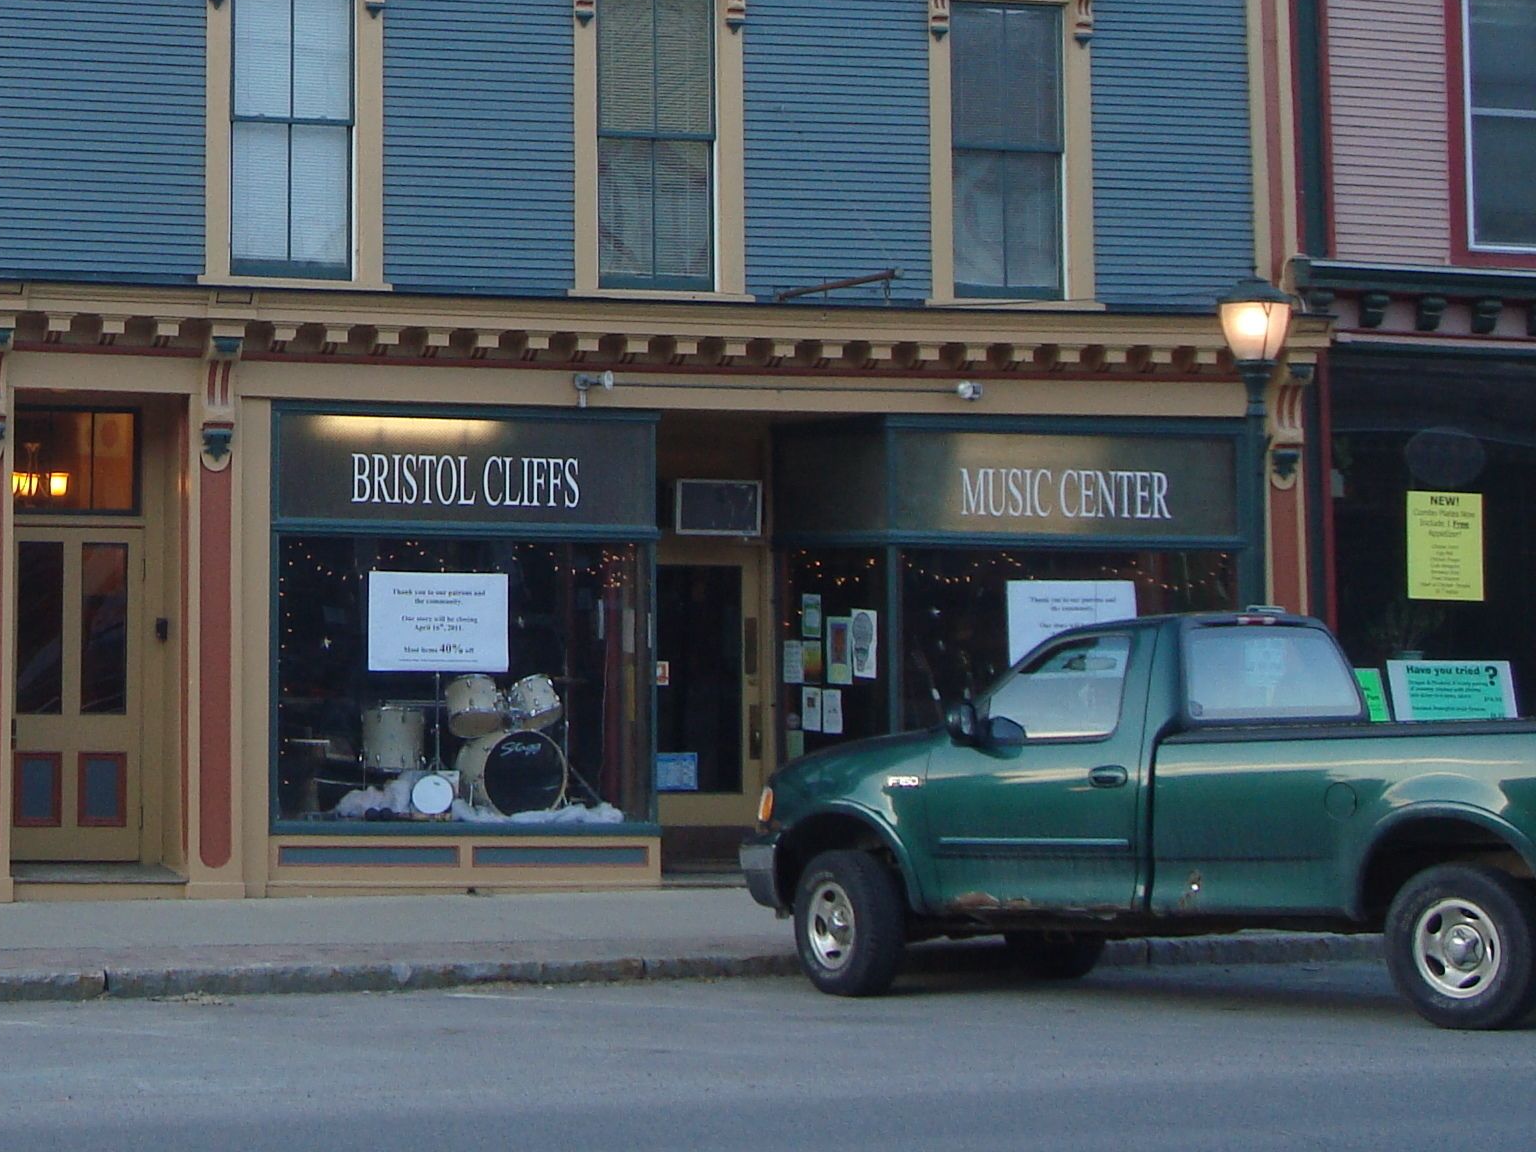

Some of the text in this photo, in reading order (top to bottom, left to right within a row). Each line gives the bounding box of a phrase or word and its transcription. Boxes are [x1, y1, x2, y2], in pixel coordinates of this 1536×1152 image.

[350, 453, 580, 508] BRISTOL CLIFFS
[960, 467, 1172, 519] MUSIC CENTER
[1430, 495, 1460, 506] NEW!
[439, 643, 463, 654] 40%
[1406, 665, 1431, 675] Have
[1434, 667, 1452, 676] you
[1455, 666, 1480, 675] tried
